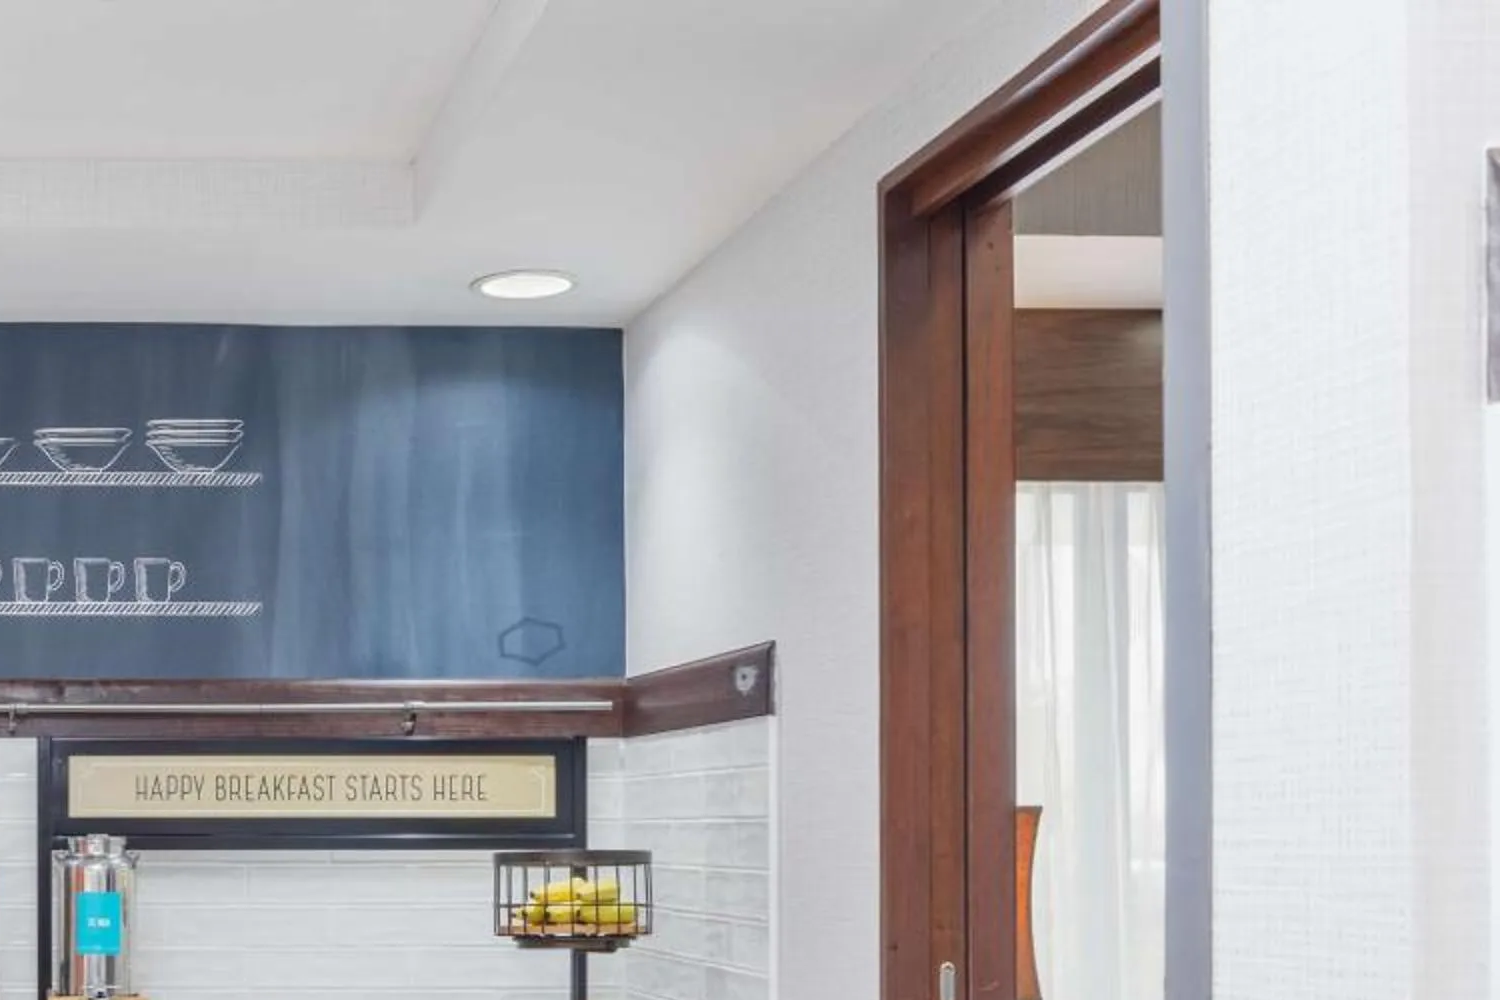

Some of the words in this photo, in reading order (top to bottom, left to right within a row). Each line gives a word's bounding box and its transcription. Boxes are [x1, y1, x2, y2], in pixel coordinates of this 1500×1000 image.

[135, 774, 205, 801] HAPPY
[215, 774, 336, 801] BREAKFAST
[345, 774, 423, 801] STARTS
[433, 774, 489, 801] HERE
